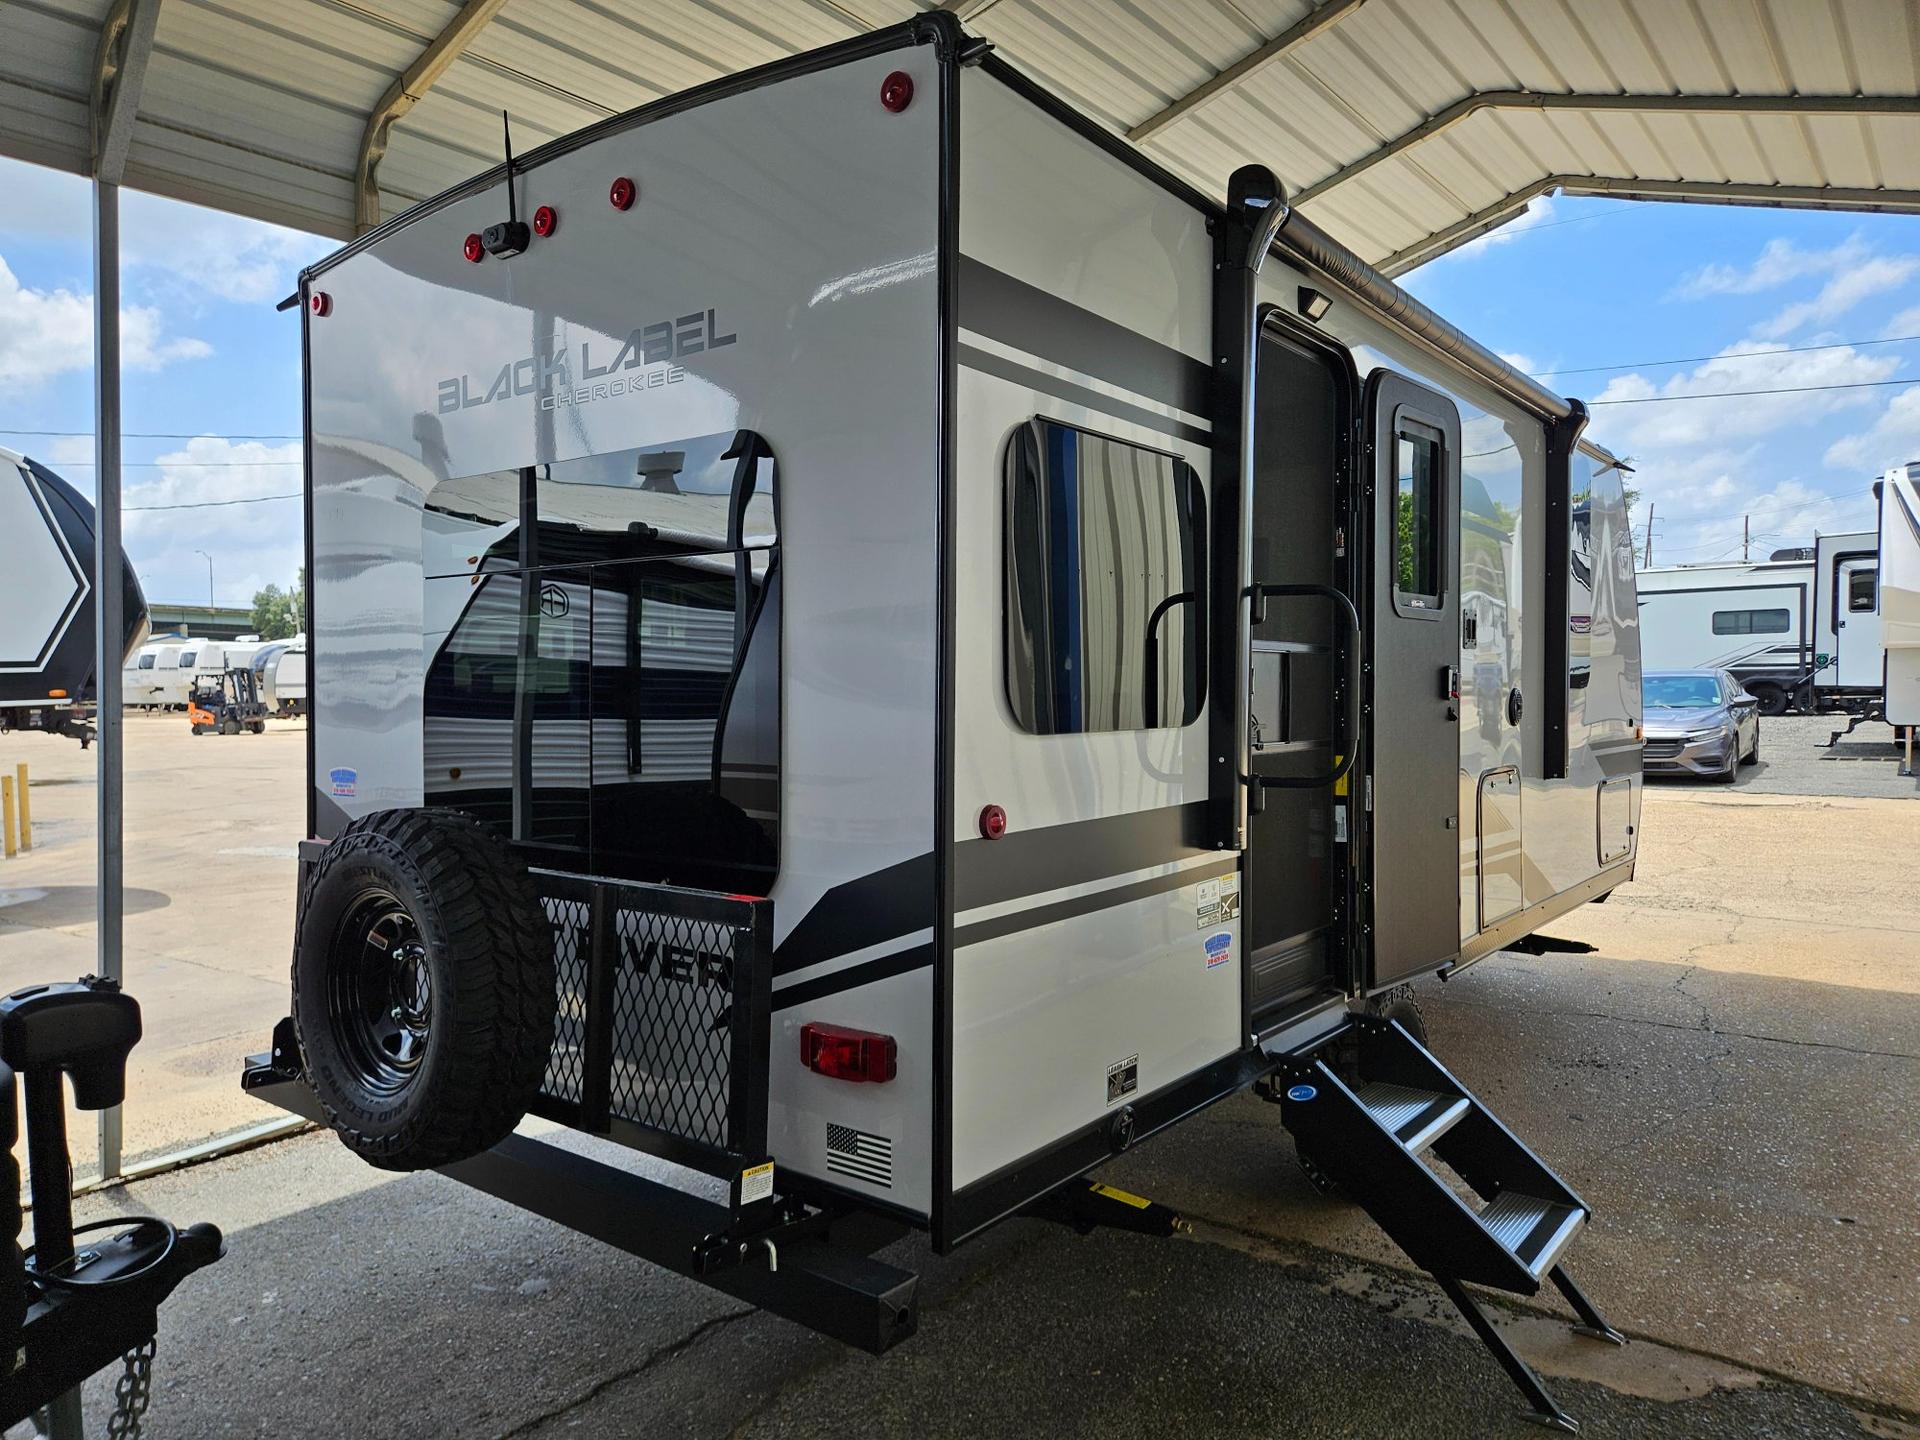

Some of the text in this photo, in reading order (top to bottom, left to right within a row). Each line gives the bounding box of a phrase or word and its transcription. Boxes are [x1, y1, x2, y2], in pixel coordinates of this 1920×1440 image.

[438, 308, 737, 415] BLACK LABEL
[540, 366, 685, 412] CHEROKEE
